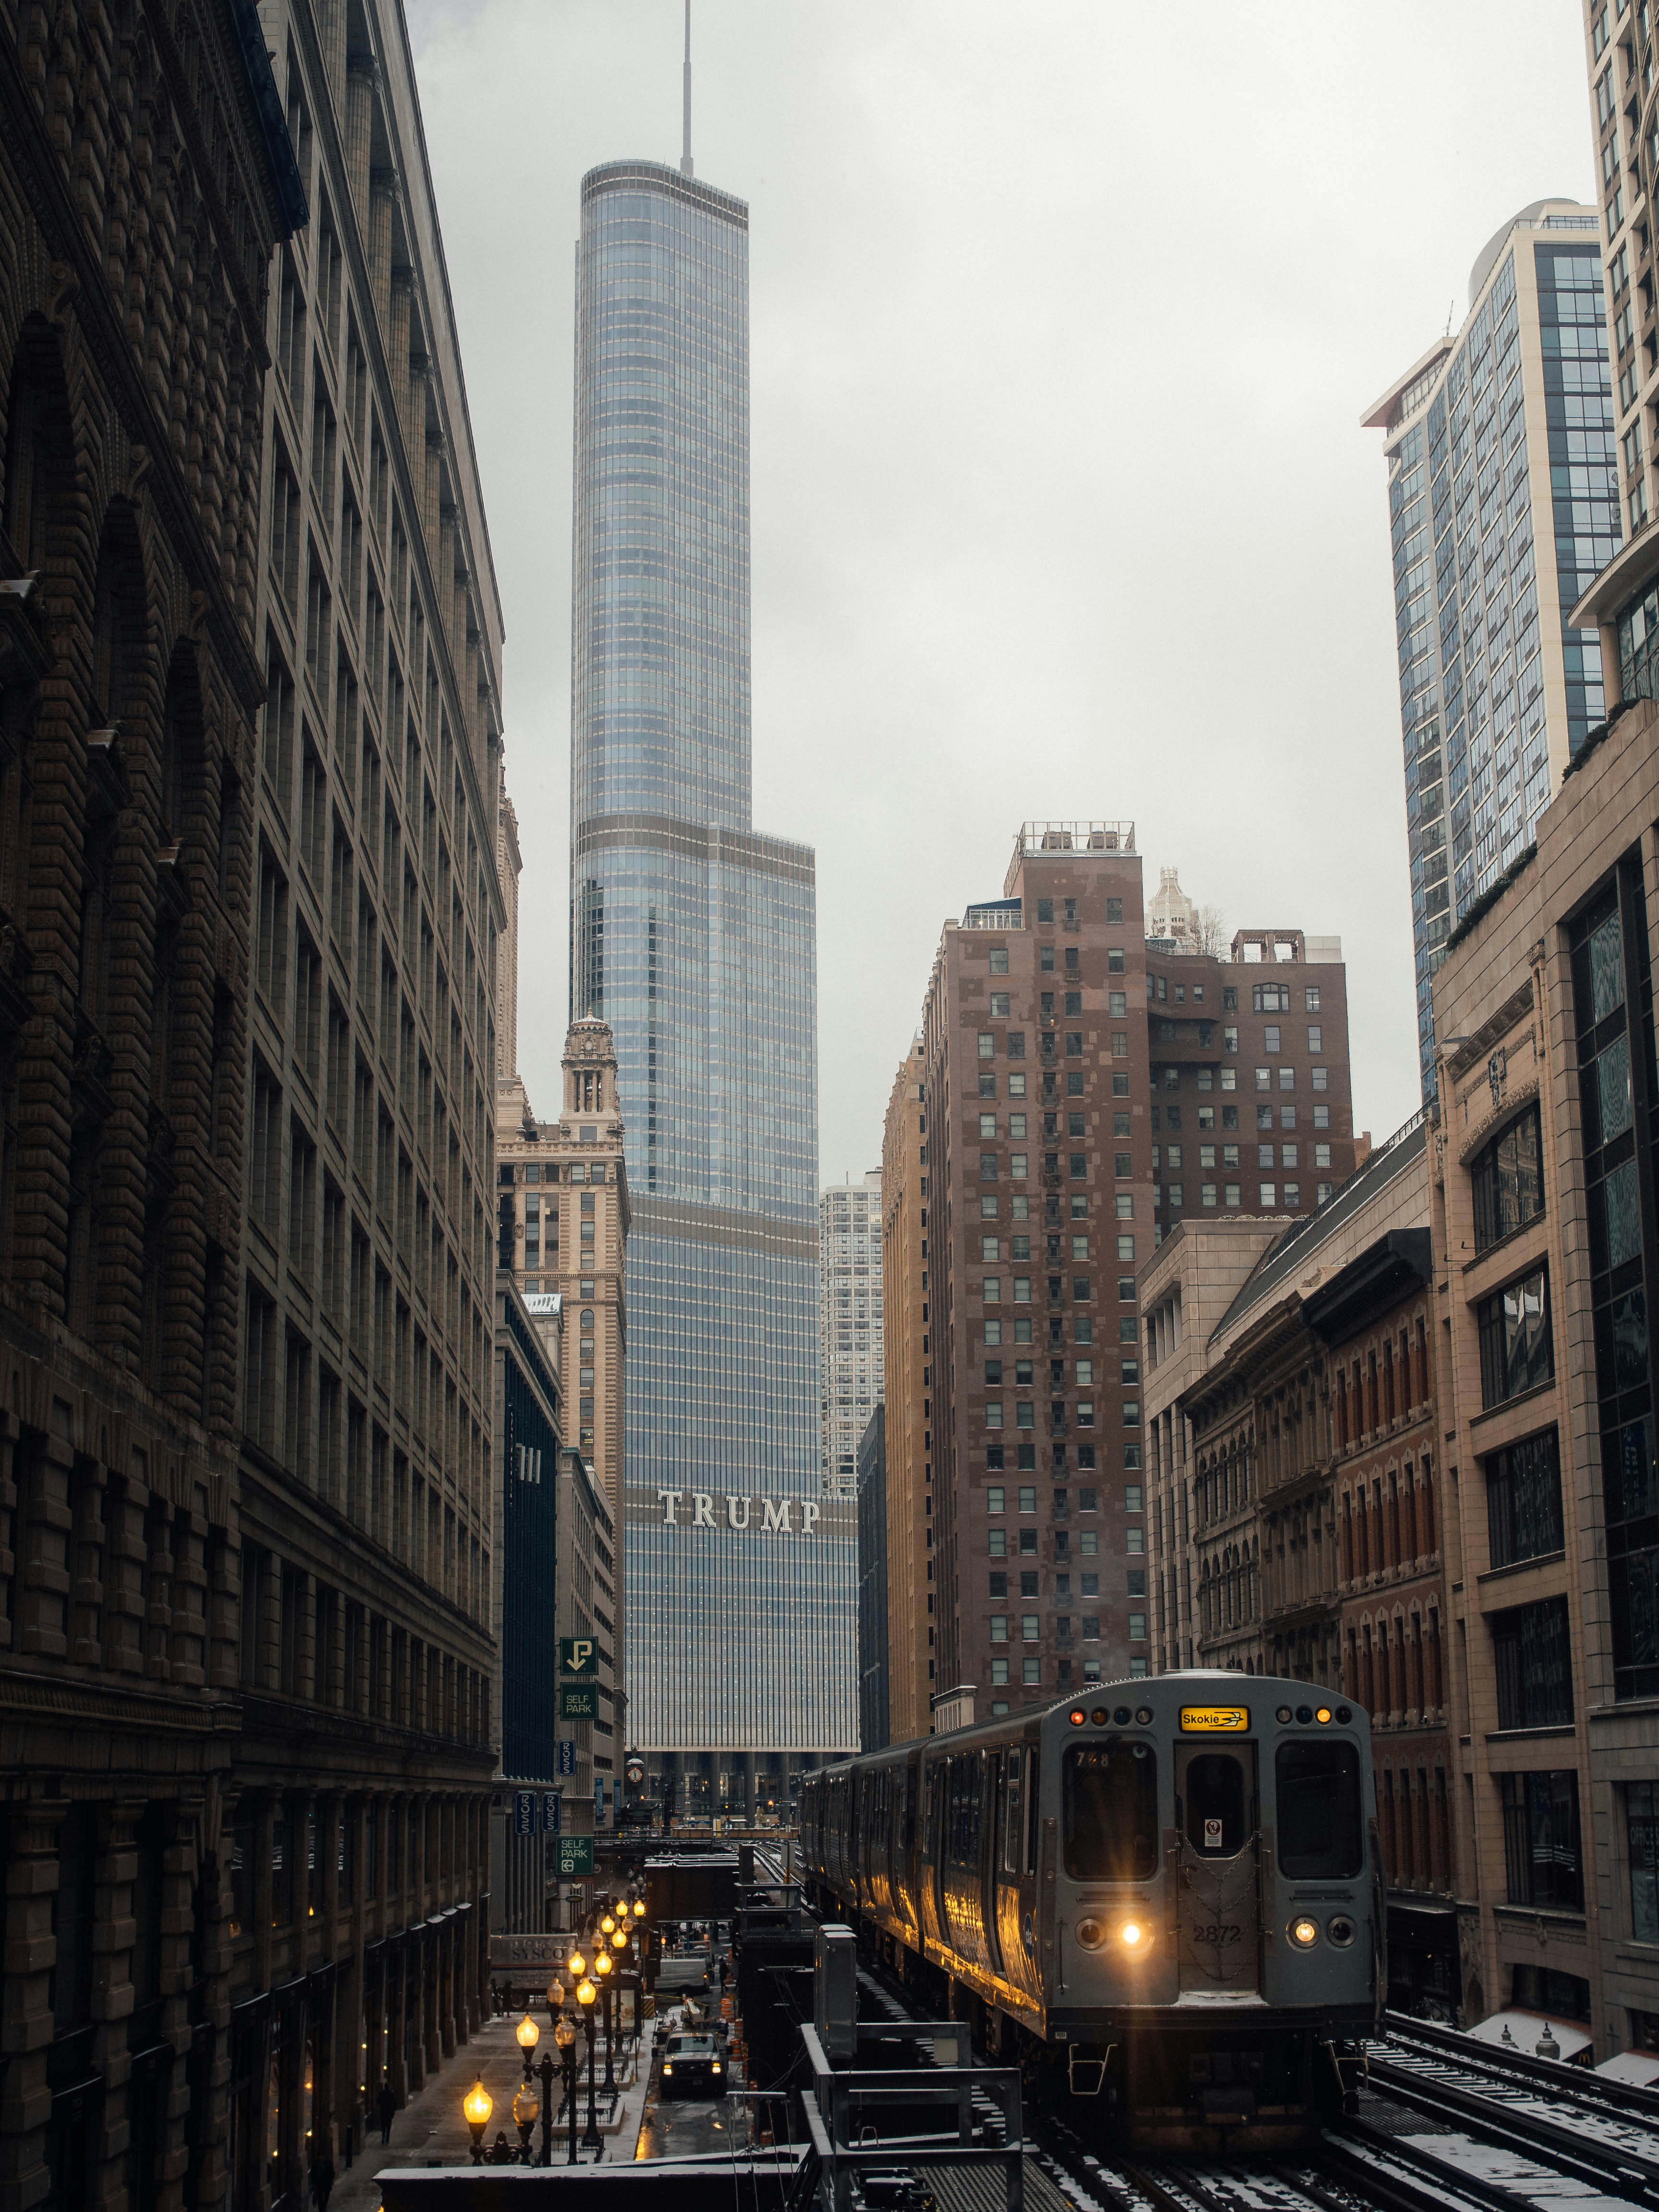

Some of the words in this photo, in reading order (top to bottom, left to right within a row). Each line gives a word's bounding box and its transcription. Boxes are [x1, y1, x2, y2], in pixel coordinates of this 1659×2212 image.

[657, 1489, 820, 1534] TRUMP
[566, 1695, 589, 1704] SELF
[566, 1705, 592, 1713] PARK
[1183, 1714, 1219, 1724] Skokie
[521, 1795, 530, 1833] ROSS
[546, 1796, 555, 1830] ROSS
[561, 1839, 584, 1848] SELF
[561, 1850, 588, 1858] PARK
[1193, 1925, 1241, 1942] 2872
[512, 1948, 565, 1960] SYSCO
